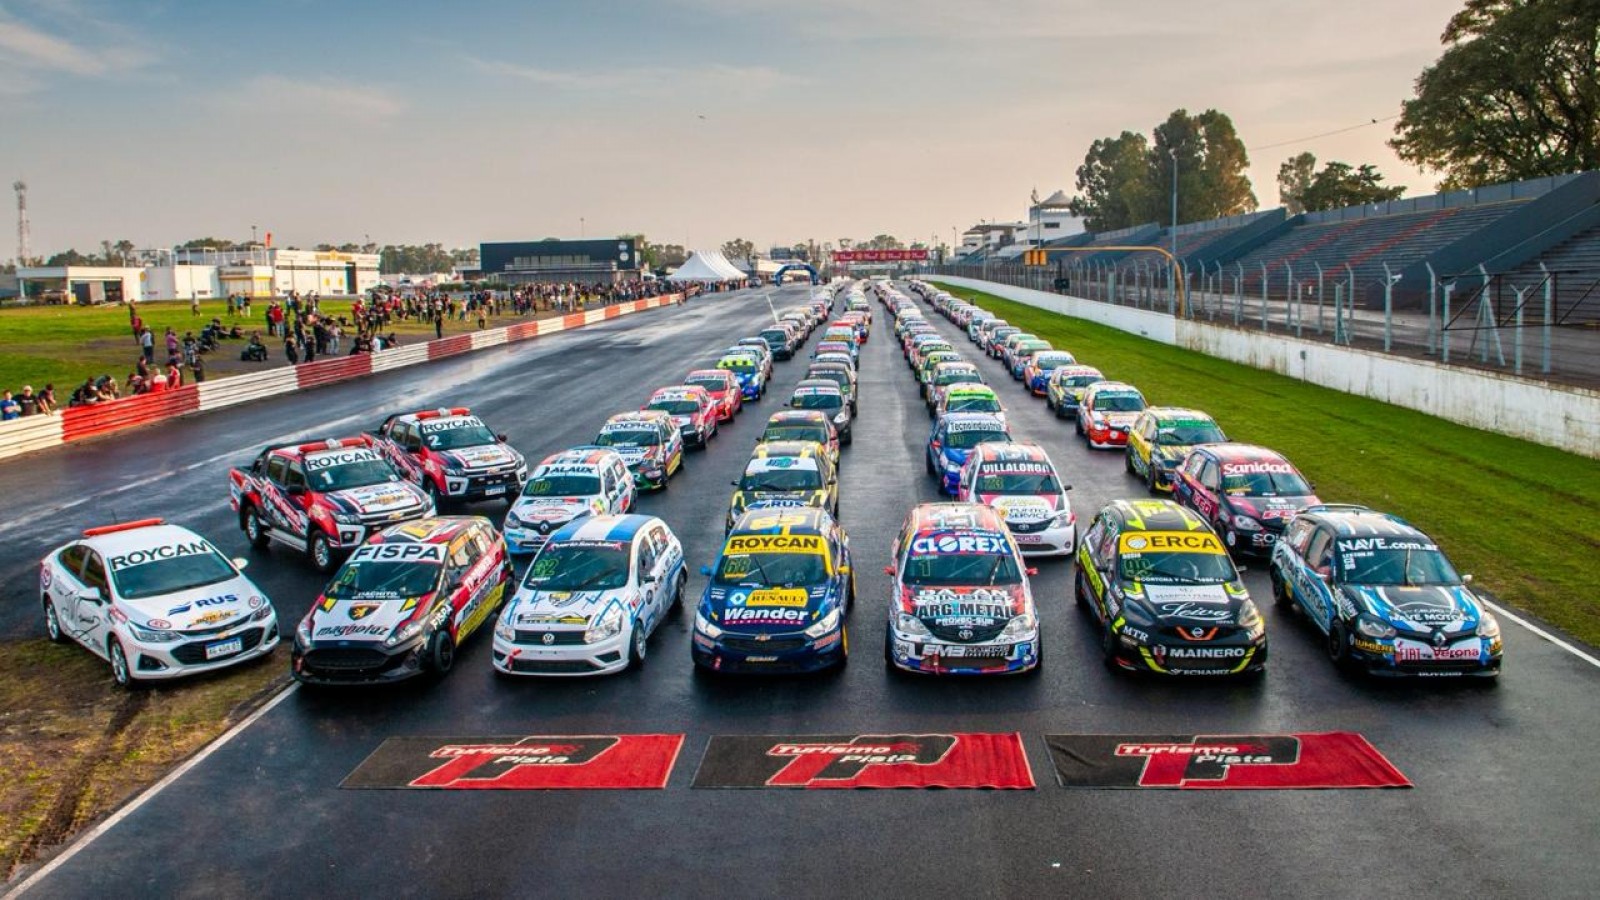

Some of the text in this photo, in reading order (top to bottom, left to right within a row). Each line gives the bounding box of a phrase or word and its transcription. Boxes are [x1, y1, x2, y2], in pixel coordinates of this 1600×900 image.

[424, 419, 481, 432] ROYCAN
[428, 434, 442, 447] 2
[307, 449, 378, 470] ROYCAN
[982, 463, 1050, 472] VILLALONGA
[1223, 462, 1291, 475] Sanidad
[321, 471, 334, 484] 1
[729, 537, 819, 550] ROYCAN
[912, 536, 1008, 553] CLOREX
[1150, 535, 1218, 550] ERCA
[1337, 538, 1439, 552] NAVE.com.ar
[110, 540, 209, 570] ROYCAN
[353, 544, 441, 561] FISPA
[195, 594, 238, 607] RUS
[724, 607, 809, 620] Wander
[919, 603, 1013, 618] ARG METAL
[1122, 625, 1149, 642] MTR
[1170, 648, 1245, 658] MAINERO
[1433, 646, 1480, 658] Verona
[438, 747, 551, 755] Turismo
[779, 745, 891, 754] Turismo
[1121, 745, 1239, 754] Turismo
[492, 755, 570, 764] Pista
[838, 754, 916, 763] Pista
[1195, 754, 1272, 763] Pista
